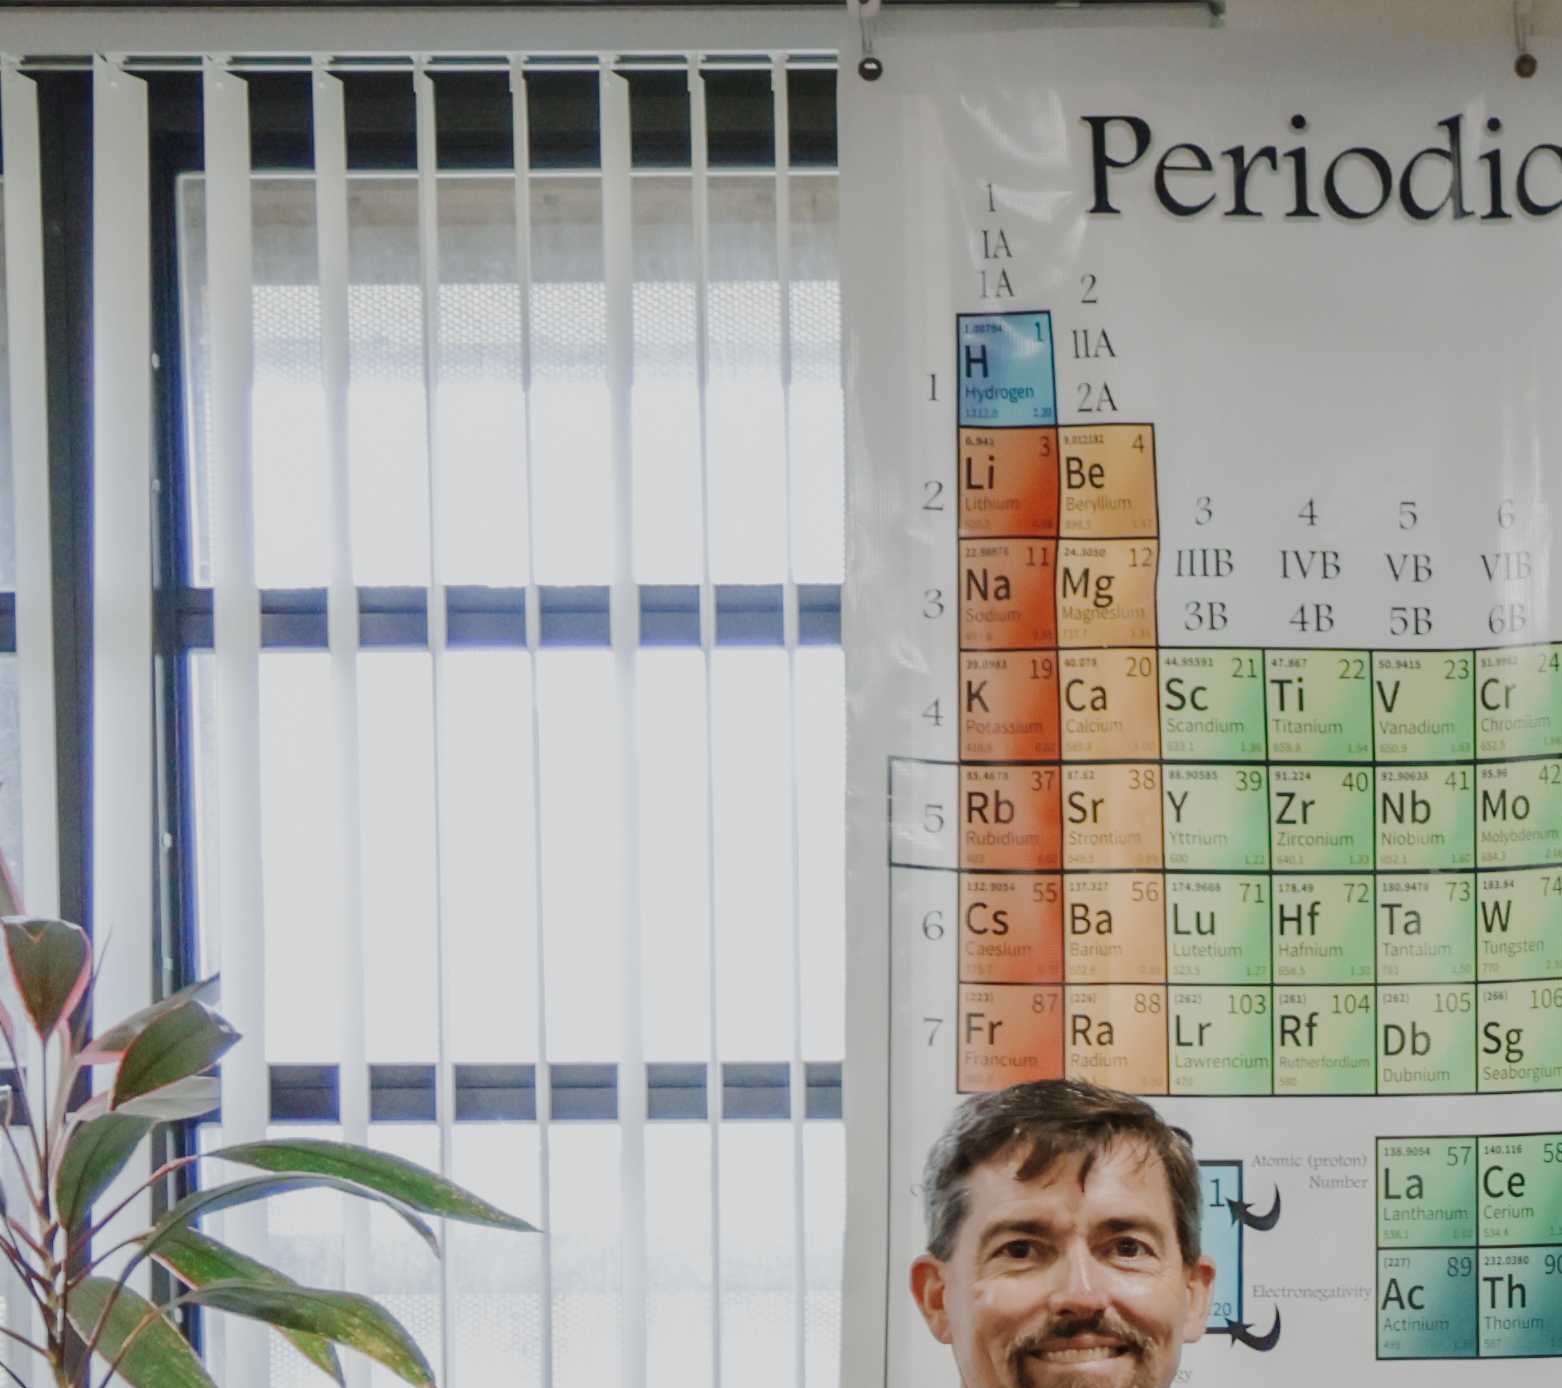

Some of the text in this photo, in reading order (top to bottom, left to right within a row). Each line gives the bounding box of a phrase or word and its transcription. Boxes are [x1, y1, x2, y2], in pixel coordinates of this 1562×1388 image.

[1073, 329, 1116, 359] IIA
[1078, 382, 1118, 412] 2A
[1177, 549, 1233, 576] IIIB
[1281, 550, 1340, 579] IVB
[1185, 601, 1228, 631] 3B
[1290, 604, 1334, 632] 4B
[1166, 678, 1208, 711] Sc
[1270, 677, 1303, 711] Ti
[1166, 718, 1246, 733] Scandium
[1272, 718, 1343, 734] Titanium
[1276, 792, 1315, 824] Zr
[1277, 832, 1354, 848] Zirconium
[1308, 1176, 1368, 1190] Number
[1384, 1168, 1423, 1199] La
[1383, 1204, 1469, 1222] Lanthanum
[1483, 1274, 1526, 1309] Th
[1484, 1316, 1543, 1331] Thorium
